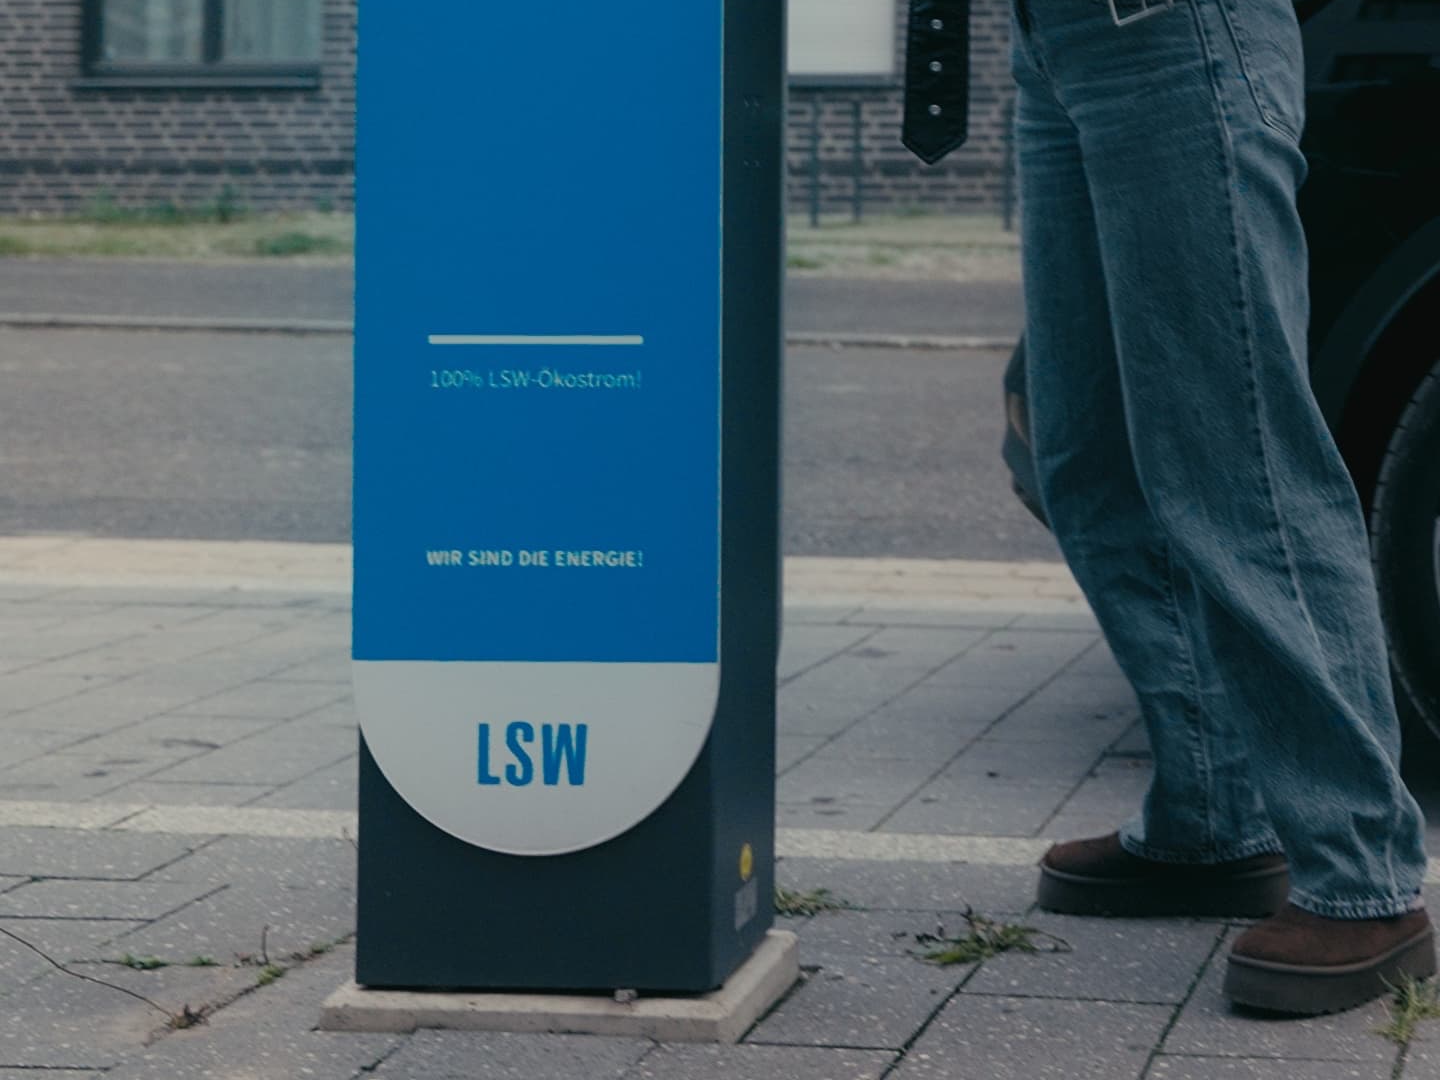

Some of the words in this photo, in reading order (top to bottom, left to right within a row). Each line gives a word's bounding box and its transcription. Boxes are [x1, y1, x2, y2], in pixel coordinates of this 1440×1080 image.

[431, 370, 482, 388] 100%
[489, 366, 642, 389] LSW-Ökostrom!
[426, 550, 463, 566] WIR
[468, 550, 513, 566] SIND
[518, 550, 549, 566] DIE
[555, 550, 643, 567] ENERGIE!
[477, 721, 588, 787] LSW
